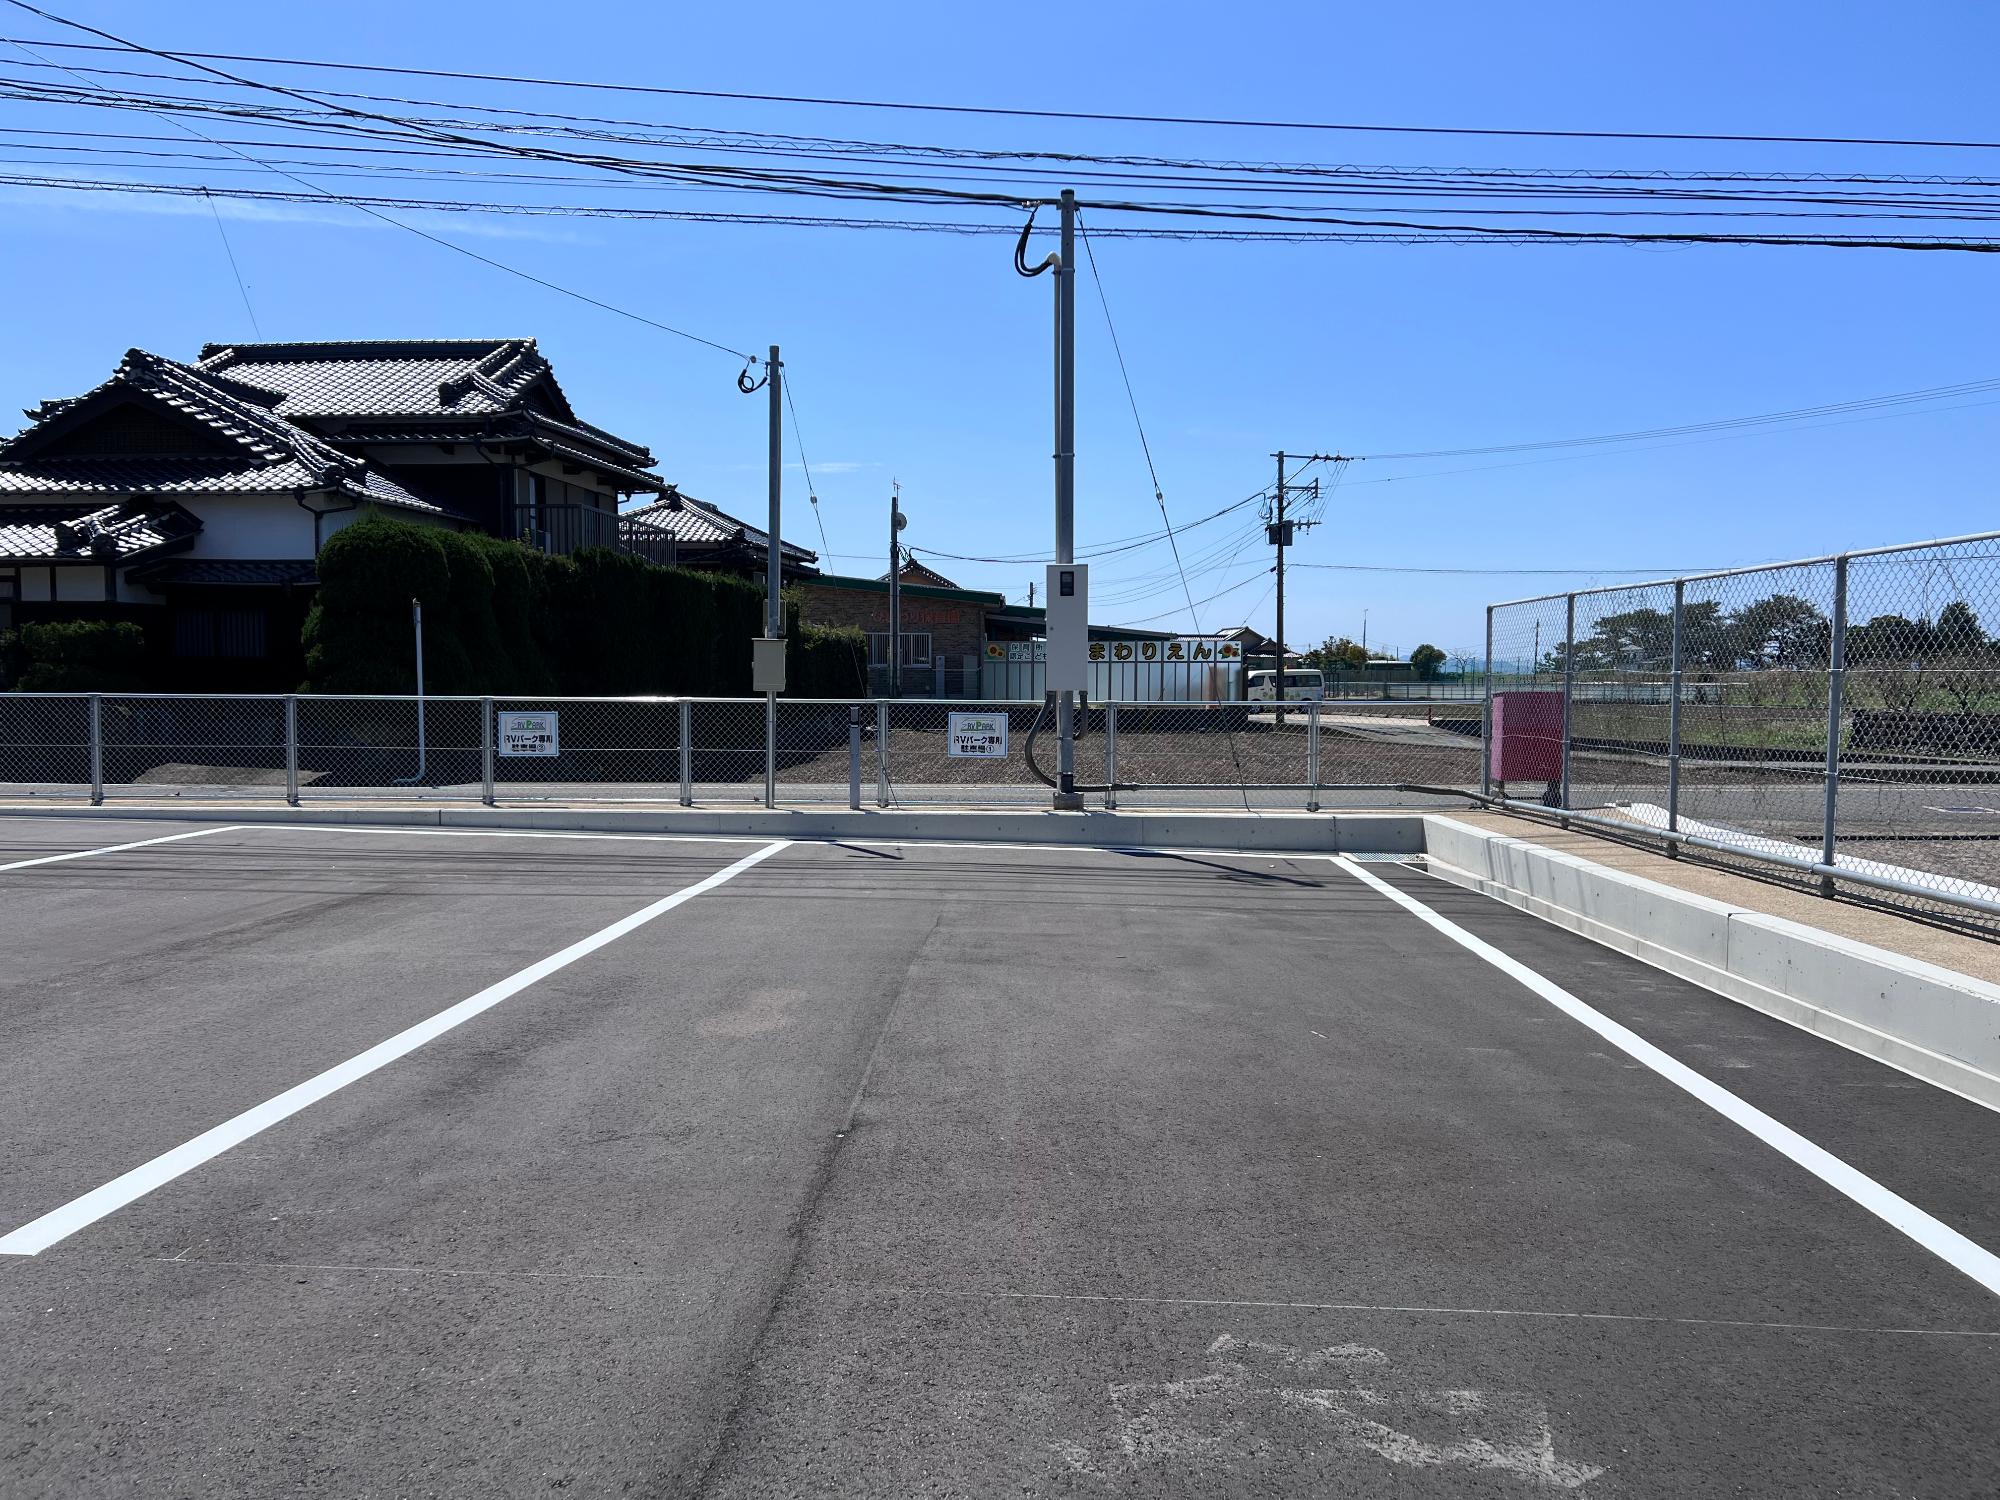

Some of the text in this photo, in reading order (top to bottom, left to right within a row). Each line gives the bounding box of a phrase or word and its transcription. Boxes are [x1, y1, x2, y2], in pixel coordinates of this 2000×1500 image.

[1089, 642, 1212, 660] まわりえん
